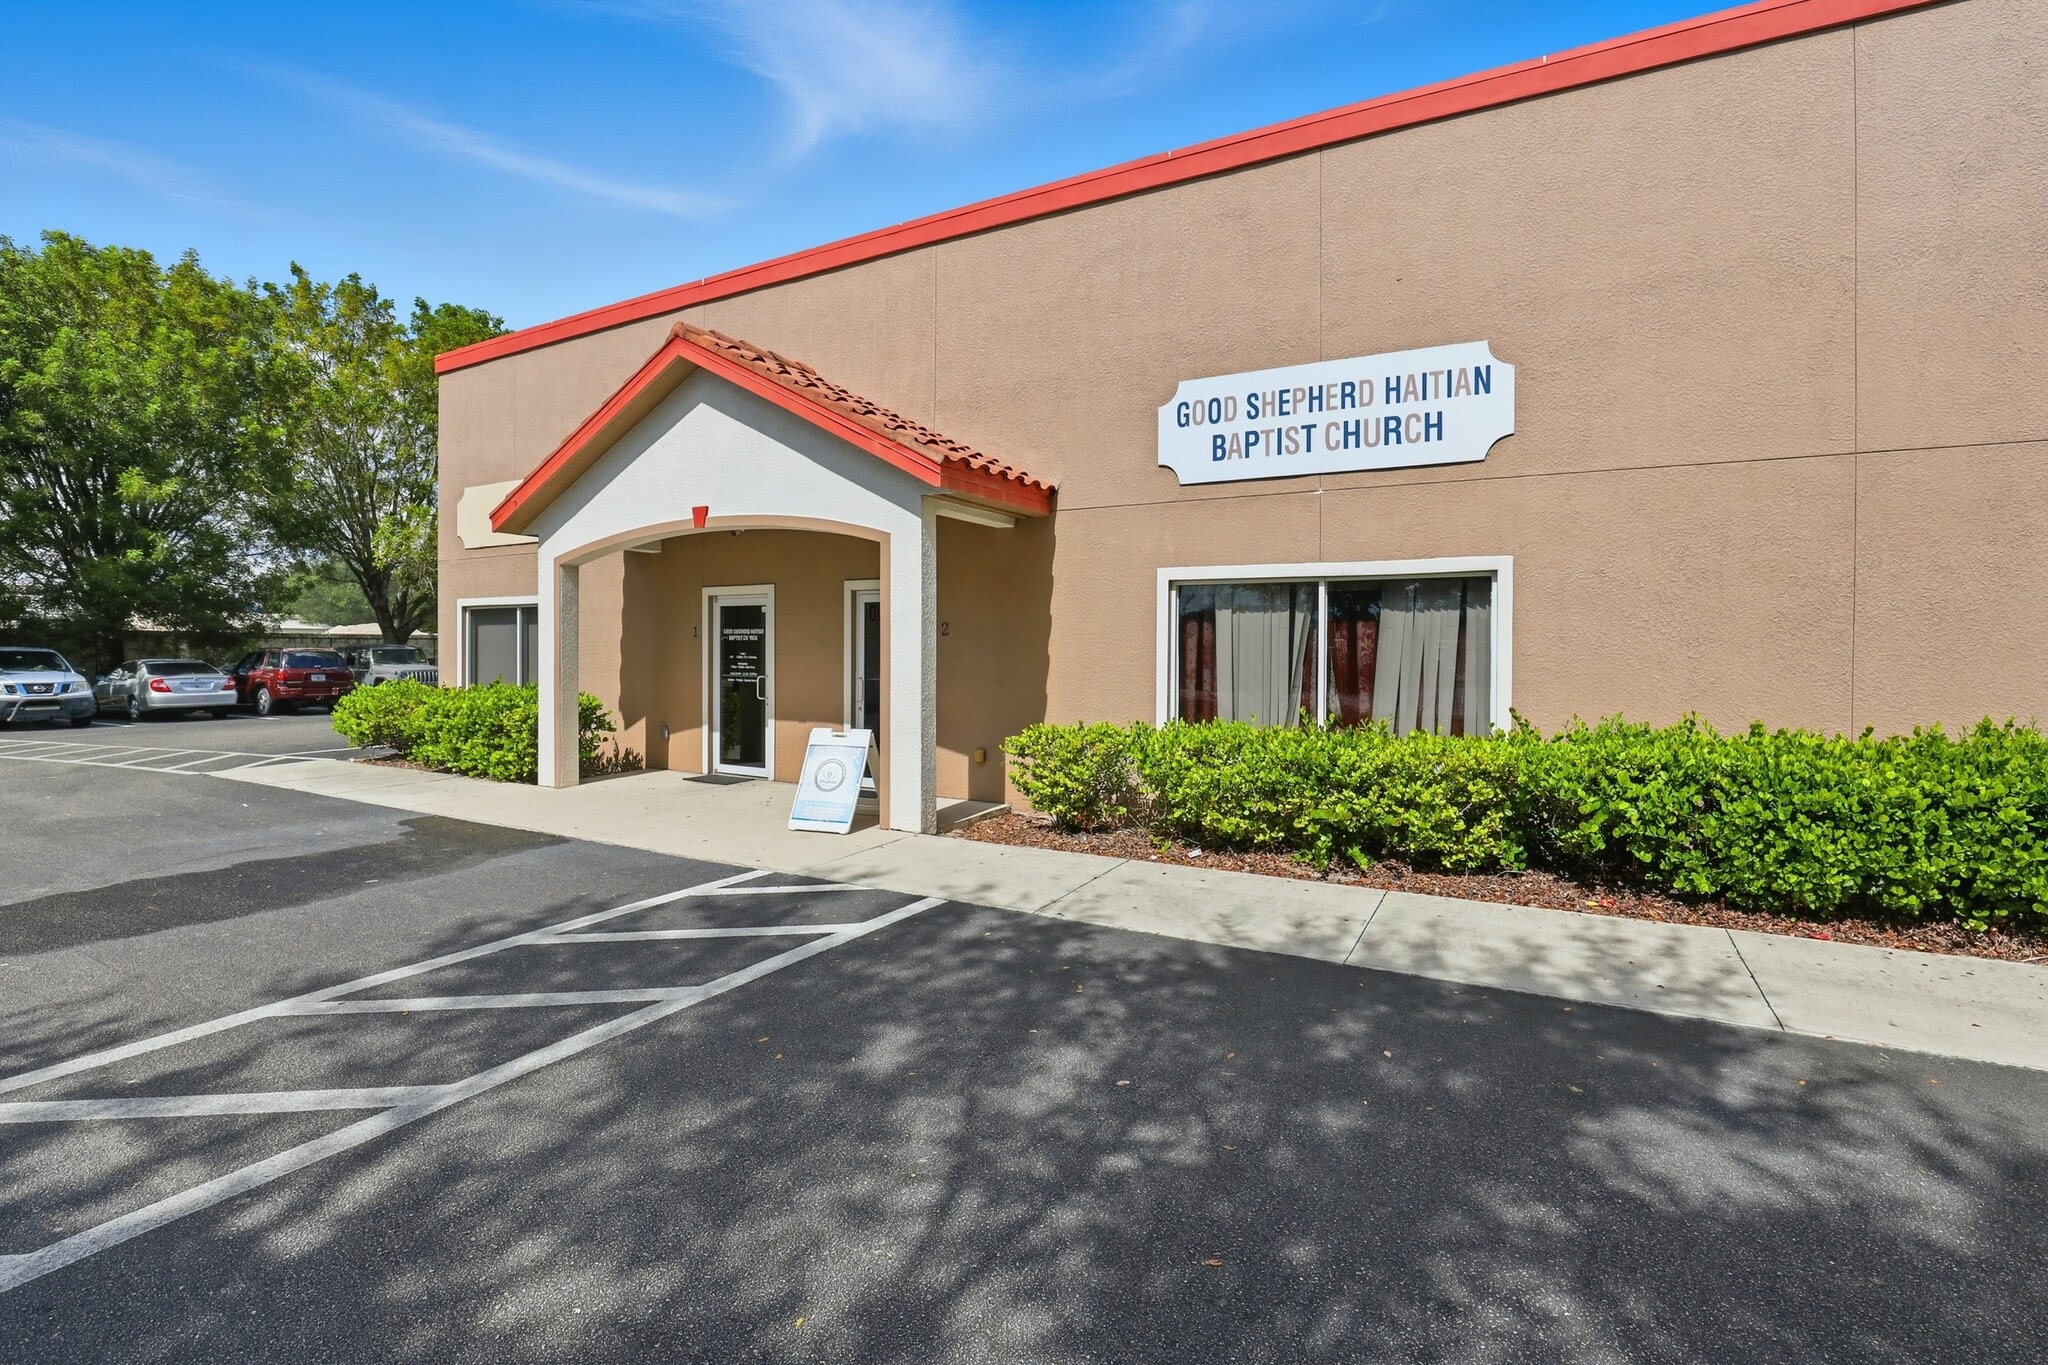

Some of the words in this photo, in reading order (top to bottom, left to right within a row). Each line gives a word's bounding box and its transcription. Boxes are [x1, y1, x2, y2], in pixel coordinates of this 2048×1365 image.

[1176, 395, 1238, 429] GOOD
[1246, 378, 1375, 421] SHEPHERD
[1384, 364, 1492, 406] HAITIAN
[1211, 423, 1318, 463] BAPTIST
[1324, 410, 1444, 452] CHURCH
[693, 626, 698, 638] 1
[941, 621, 949, 636] 2
